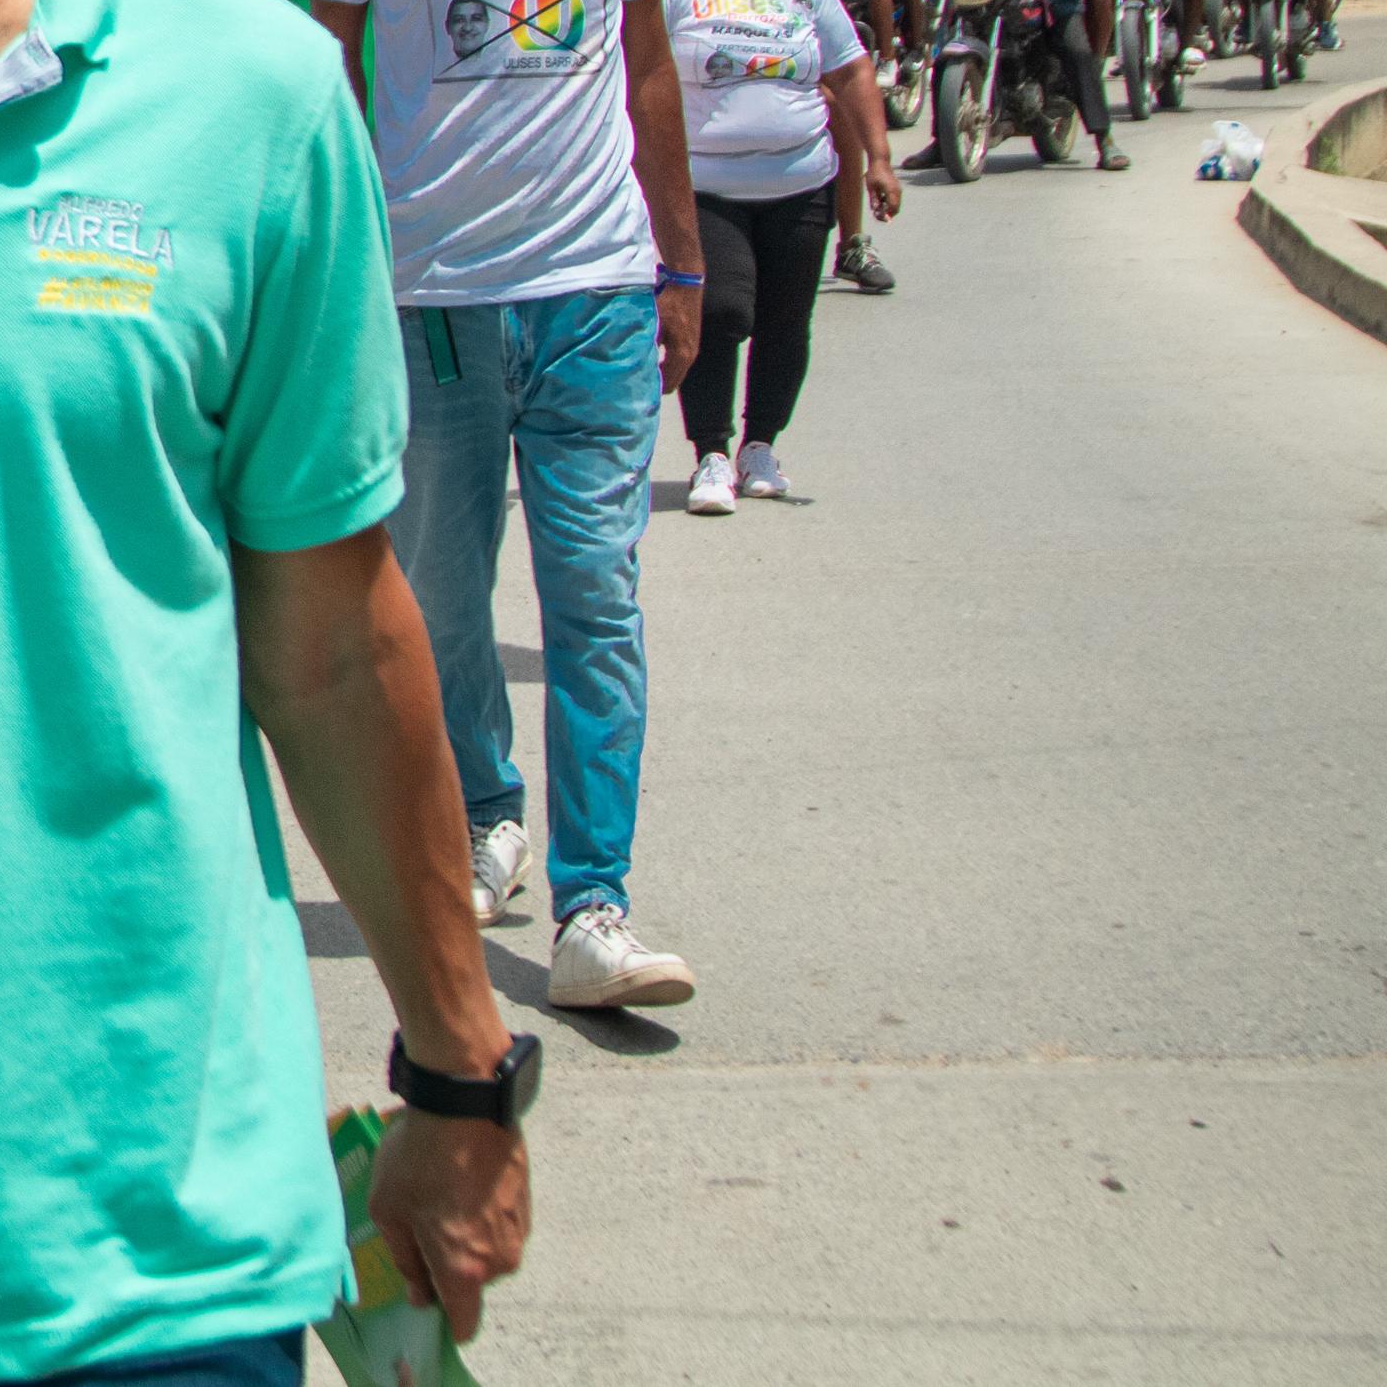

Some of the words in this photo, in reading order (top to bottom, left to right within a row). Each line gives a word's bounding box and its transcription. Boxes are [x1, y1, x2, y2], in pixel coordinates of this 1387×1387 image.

[711, 25, 772, 39] MARQUE
[504, 56, 542, 69] ULISES
[57, 195, 144, 221] ALFREDO
[26, 207, 175, 269] VARELA
